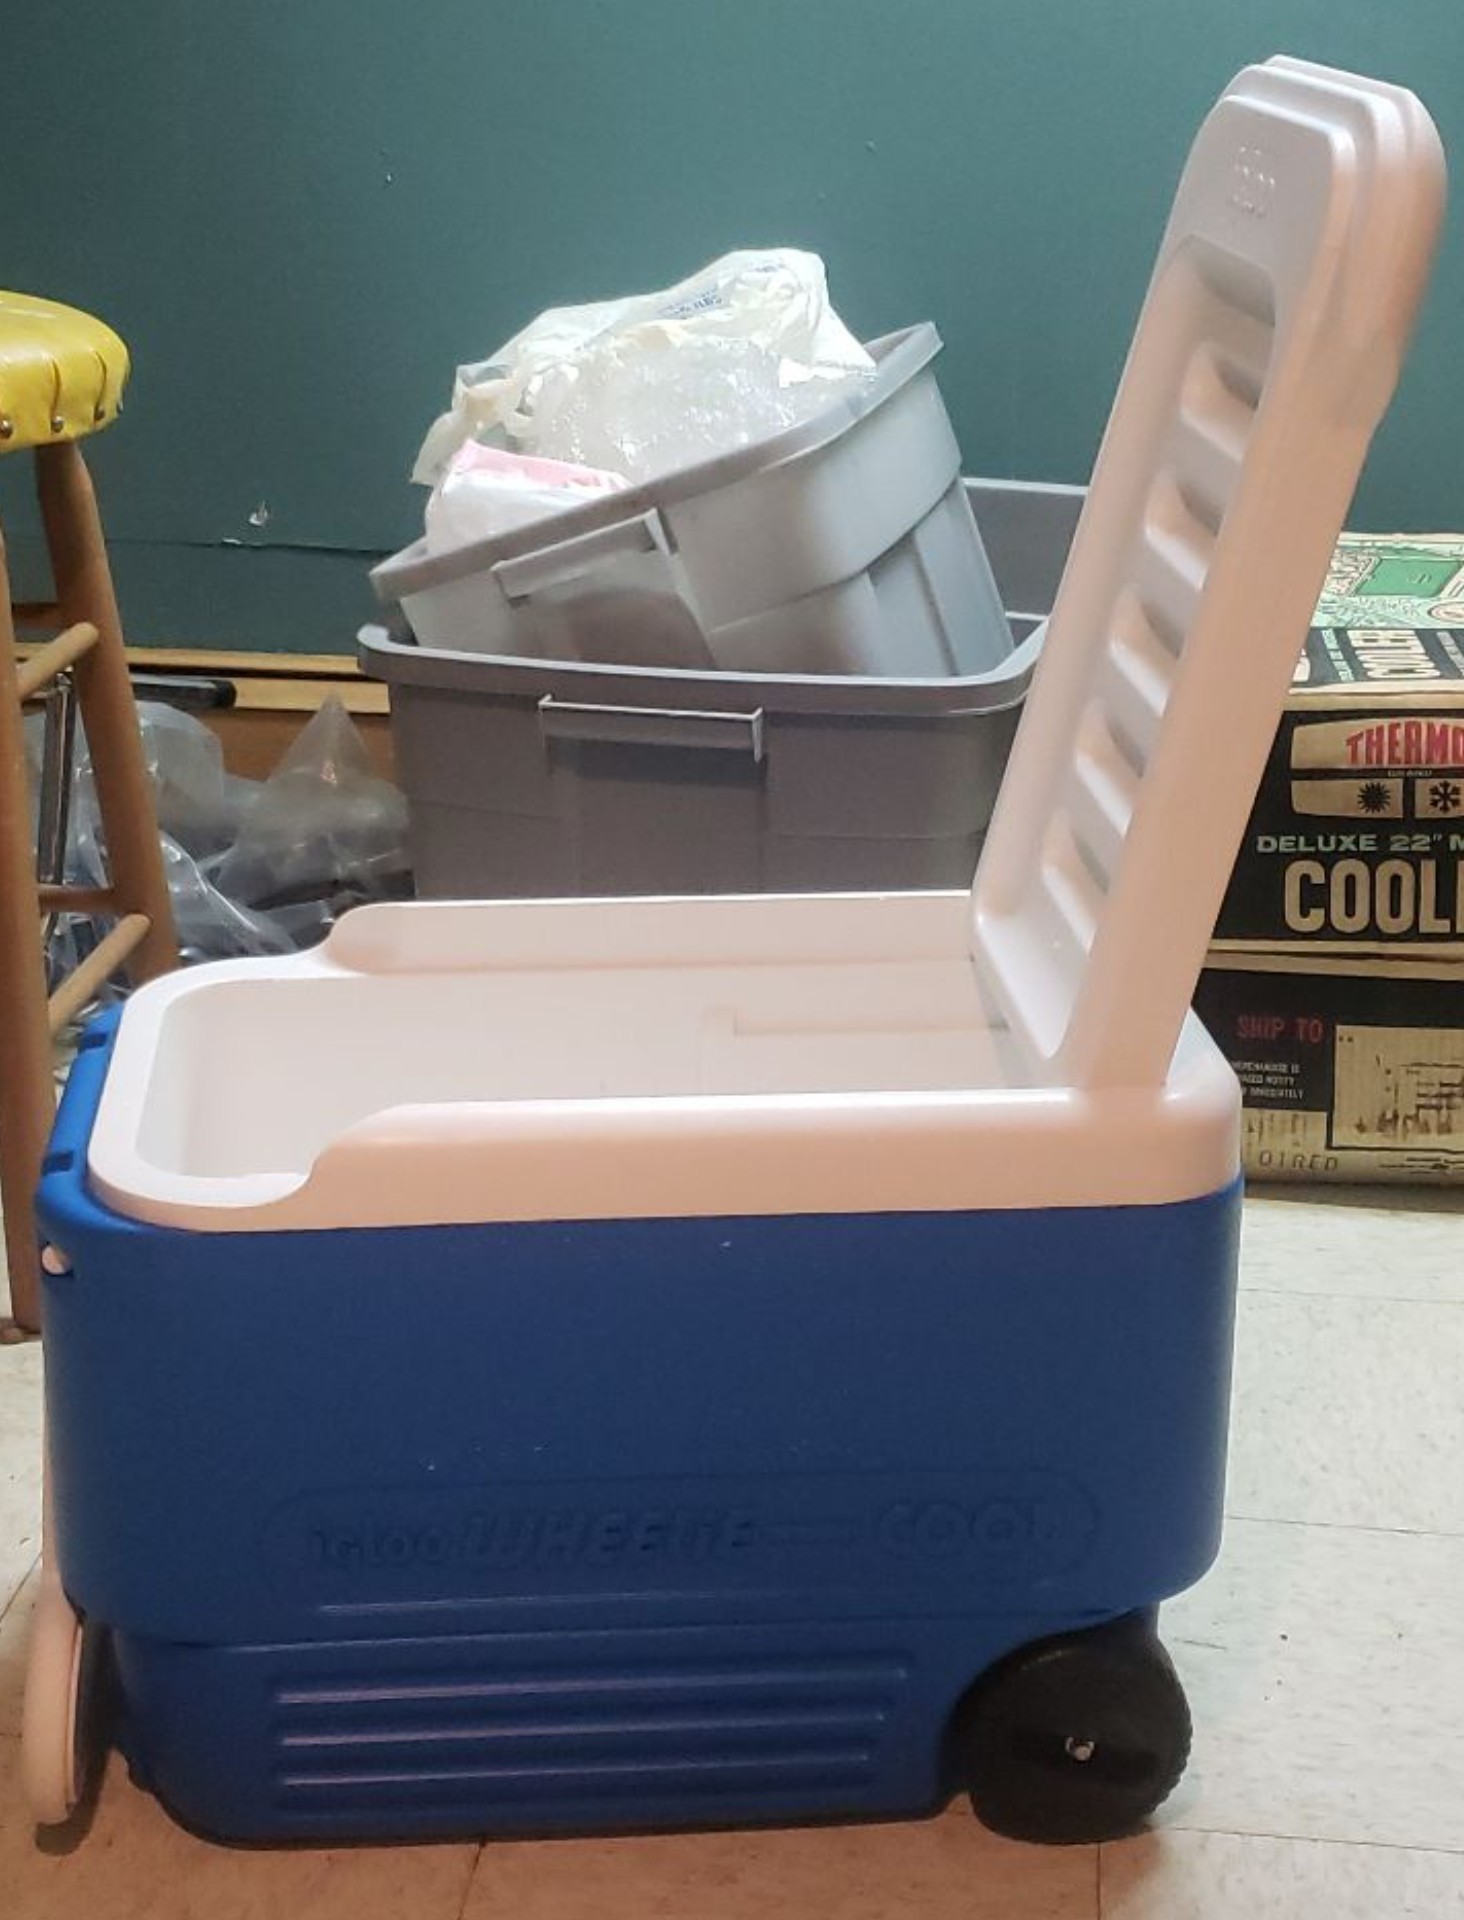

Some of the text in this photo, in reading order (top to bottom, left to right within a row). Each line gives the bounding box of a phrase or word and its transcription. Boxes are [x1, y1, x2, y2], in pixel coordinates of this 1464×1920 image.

[1256, 834, 1378, 853] DELUXE
[1238, 1016, 1324, 1042] SHIP TO
